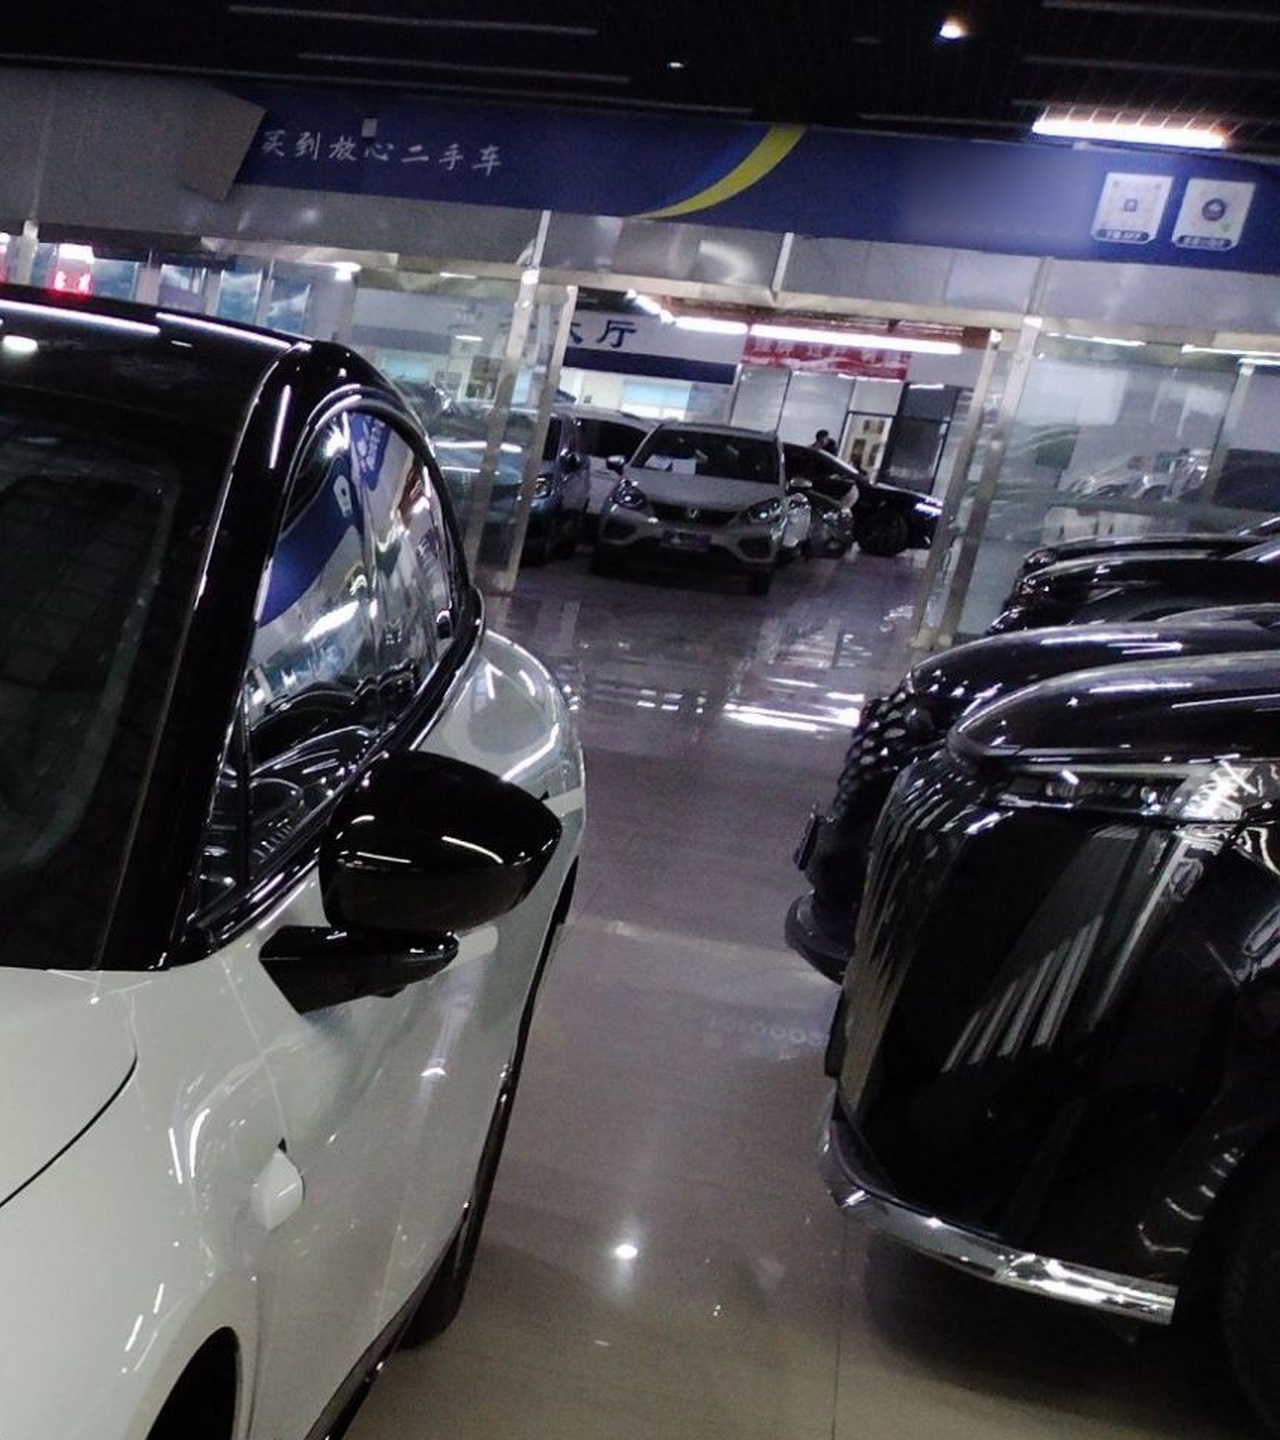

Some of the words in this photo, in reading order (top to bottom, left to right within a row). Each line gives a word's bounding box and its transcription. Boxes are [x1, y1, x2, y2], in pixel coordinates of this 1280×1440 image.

[261, 129, 502, 177] 买到放心二手车
